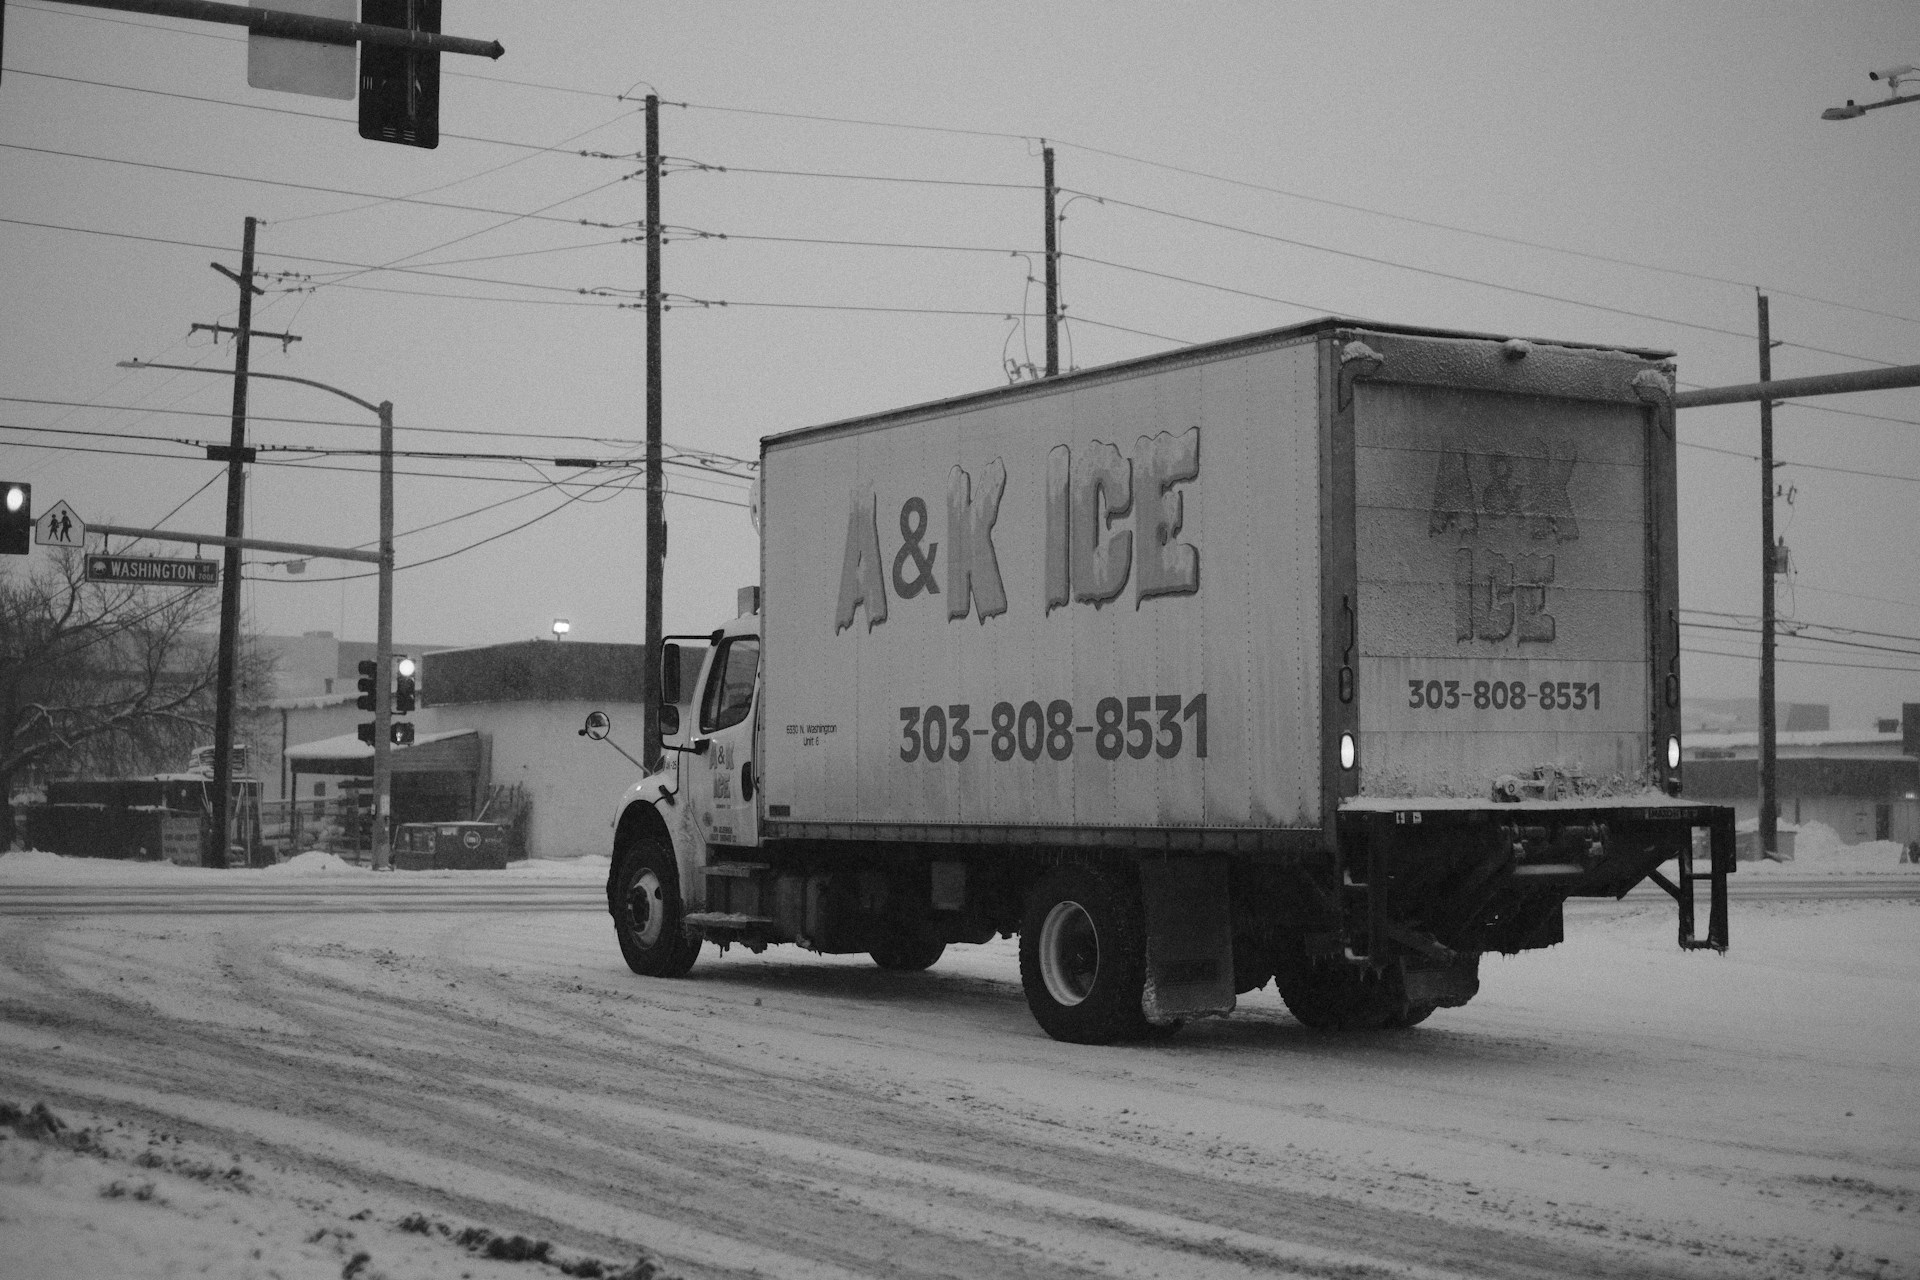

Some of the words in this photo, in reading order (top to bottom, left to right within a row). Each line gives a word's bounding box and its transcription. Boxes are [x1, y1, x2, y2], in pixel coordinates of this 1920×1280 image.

[835, 456, 1007, 637] A&K
[1045, 426, 1200, 618] ICE
[110, 561, 196, 580] WASHINGTON
[1454, 548, 1556, 647] ICE
[1408, 680, 1601, 711] 303-808-8531
[803, 736, 814, 747] Unit
[807, 723, 838, 736] Washington
[900, 693, 1208, 763] 303-808-8531
